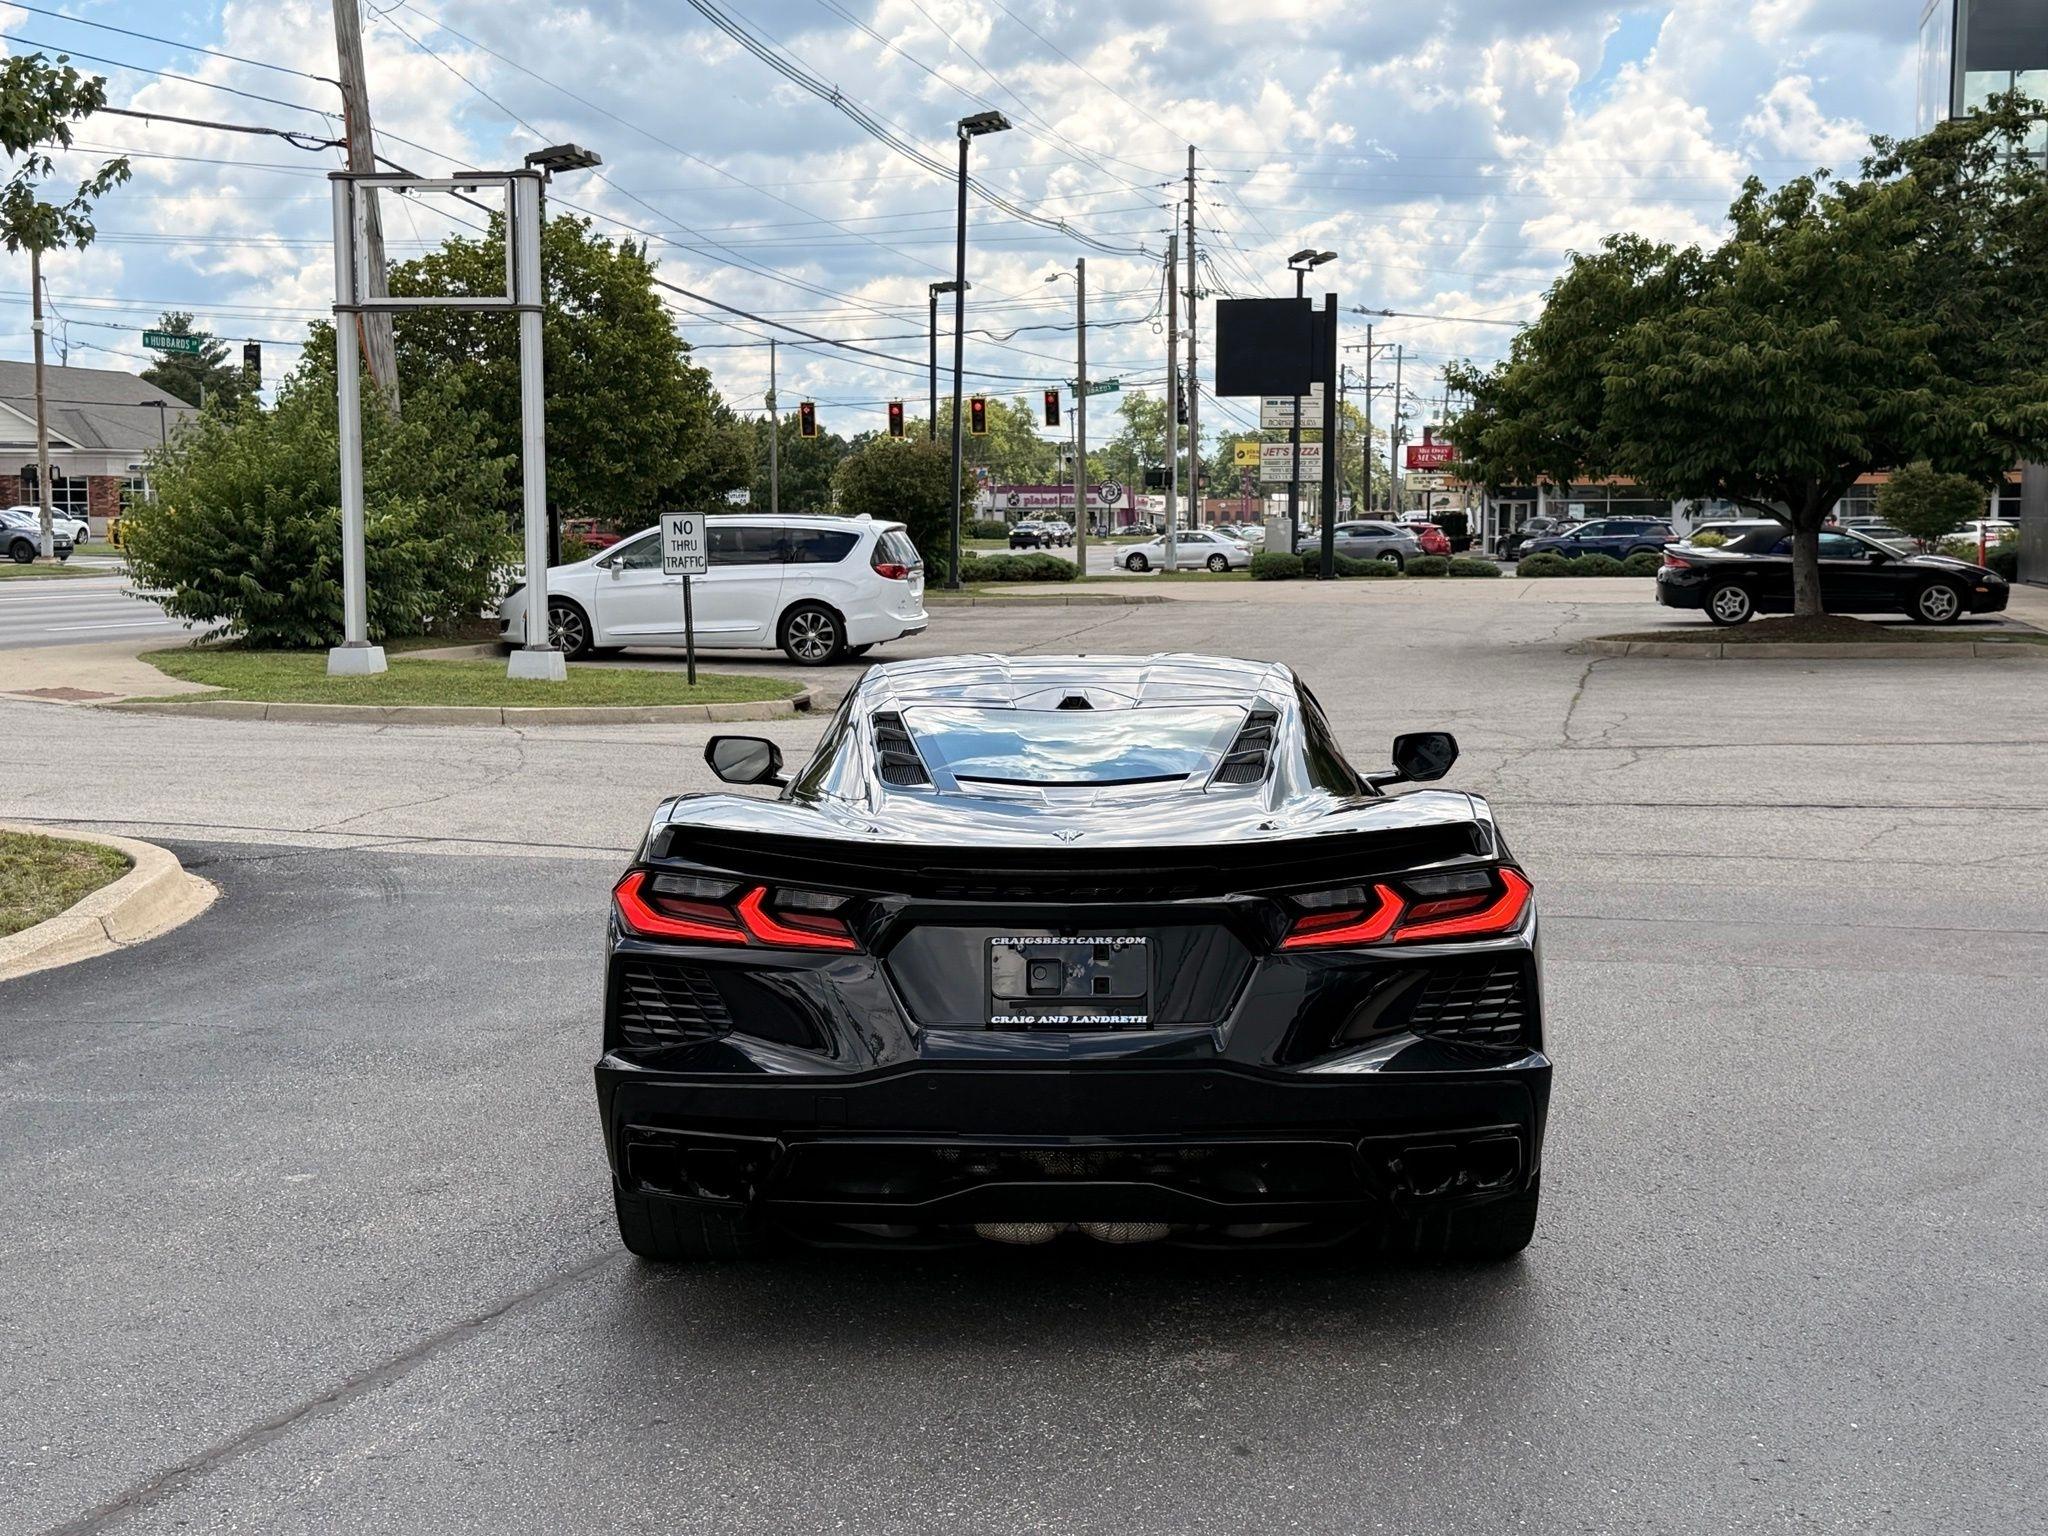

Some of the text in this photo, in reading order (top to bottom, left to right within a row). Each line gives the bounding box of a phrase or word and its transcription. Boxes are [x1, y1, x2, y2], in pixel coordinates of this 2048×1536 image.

[151, 336, 190, 349] HUBBARDS
[1263, 447, 1290, 456] JET'S
[1417, 454, 1447, 462] MUSIC
[1023, 495, 1058, 507] planet
[673, 520, 693, 535] NO
[671, 539, 697, 551] THRU
[665, 556, 705, 568] TRAFFIC
[991, 937, 1147, 945] CRAIGSBESTCARS.COM
[991, 1015, 1148, 1024] CRAIG AND LANDRETH
